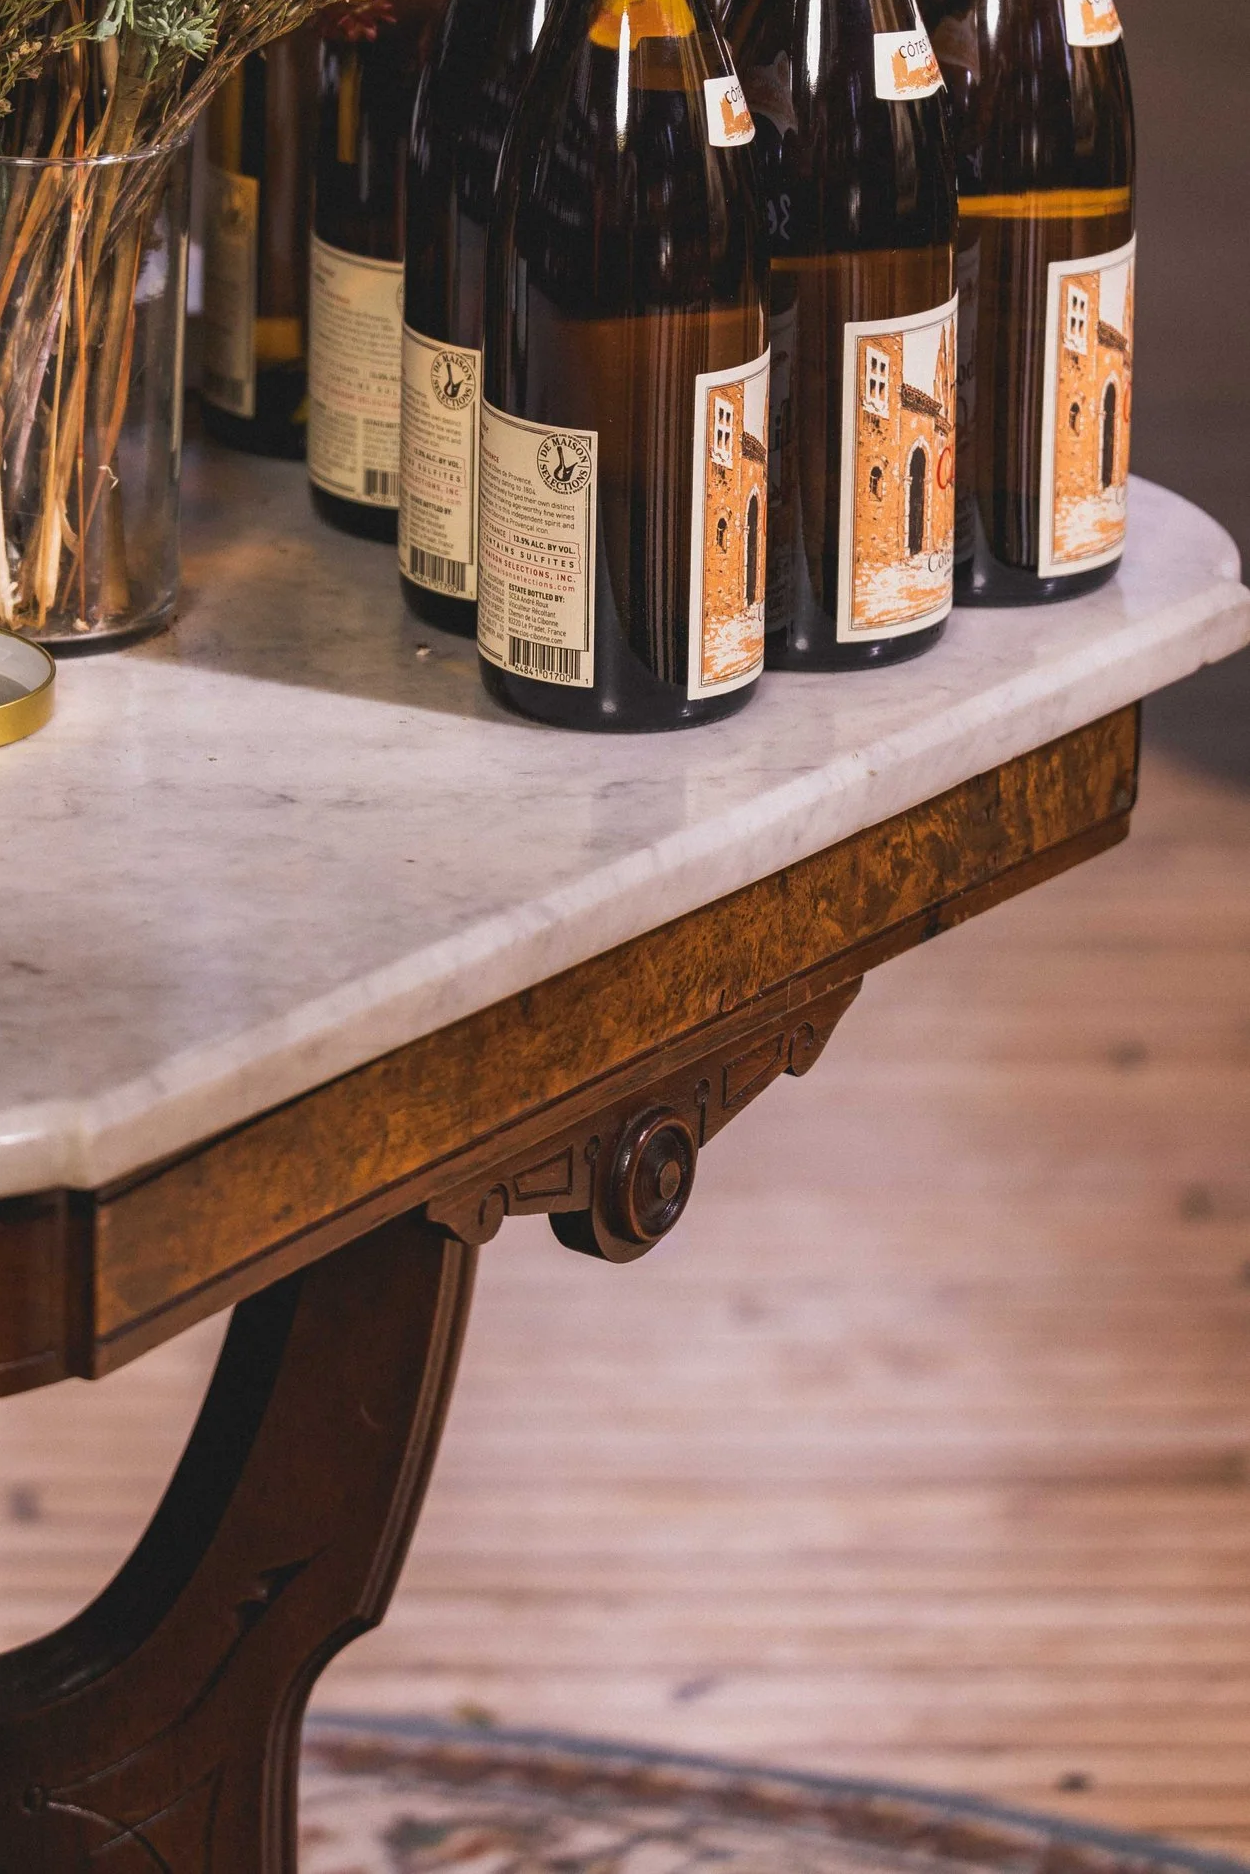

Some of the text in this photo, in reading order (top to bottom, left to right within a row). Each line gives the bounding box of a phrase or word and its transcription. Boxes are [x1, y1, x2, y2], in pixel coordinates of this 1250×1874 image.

[540, 437, 588, 463] DE MAISON
[540, 463, 588, 491] SELECTIONS
[551, 502, 575, 512] distinct
[556, 513, 575, 521] wines
[531, 540, 546, 550] ALC.
[558, 546, 576, 555] VOL.
[520, 551, 575, 569] SULFITES
[556, 573, 576, 583] INC.
[508, 583, 566, 604] ESTATE BOTTLED BY:
[537, 617, 559, 628] Cibonne
[547, 628, 567, 638] France
[514, 662, 539, 678] 64841
[542, 670, 571, 683] 01700
